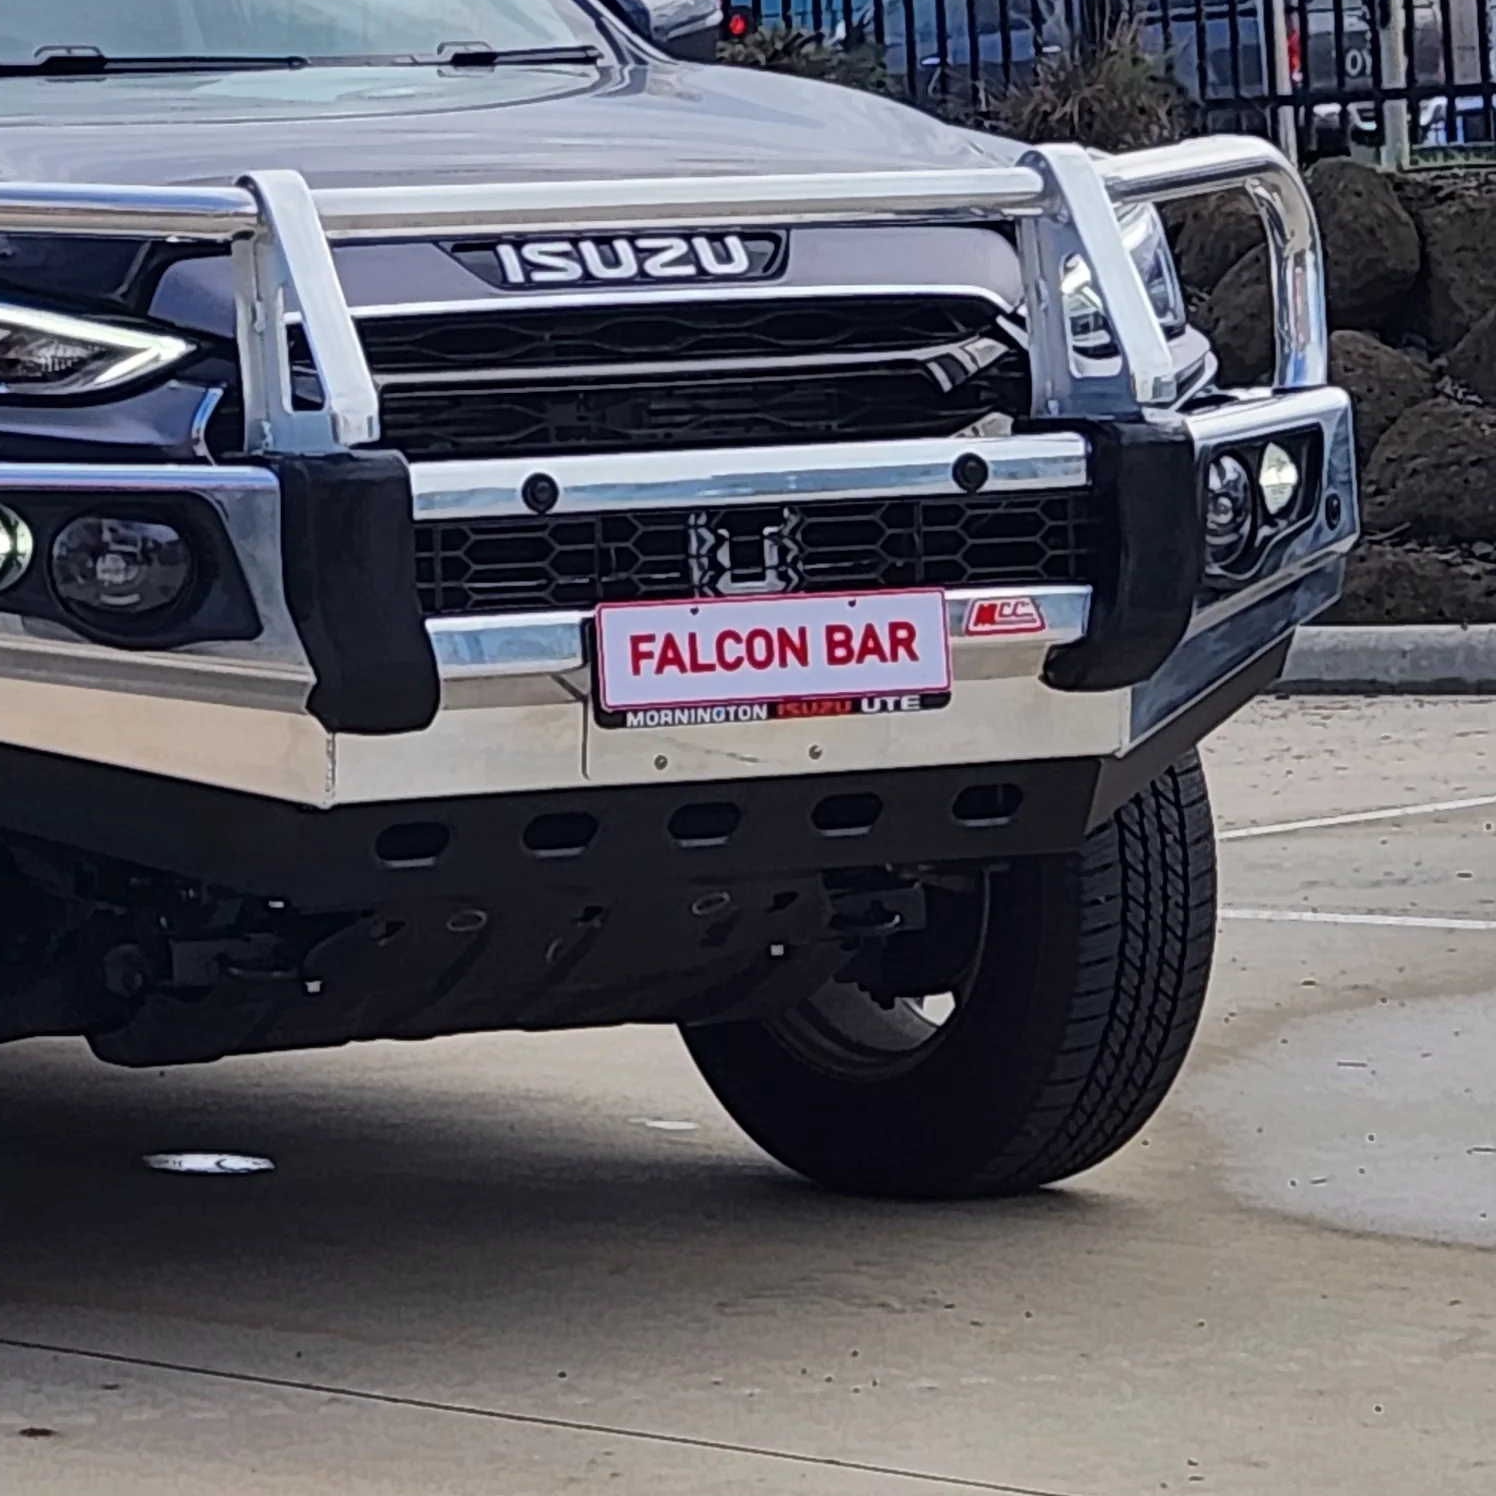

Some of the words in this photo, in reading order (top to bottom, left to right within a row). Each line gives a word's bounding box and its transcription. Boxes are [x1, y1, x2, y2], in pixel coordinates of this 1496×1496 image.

[496, 234, 750, 284] ISUZU
[629, 626, 810, 677] FALCON
[824, 620, 920, 666] BAR
[625, 703, 769, 729] MORNINGTON
[775, 699, 854, 718] ISUZU
[860, 694, 921, 714] UTE
